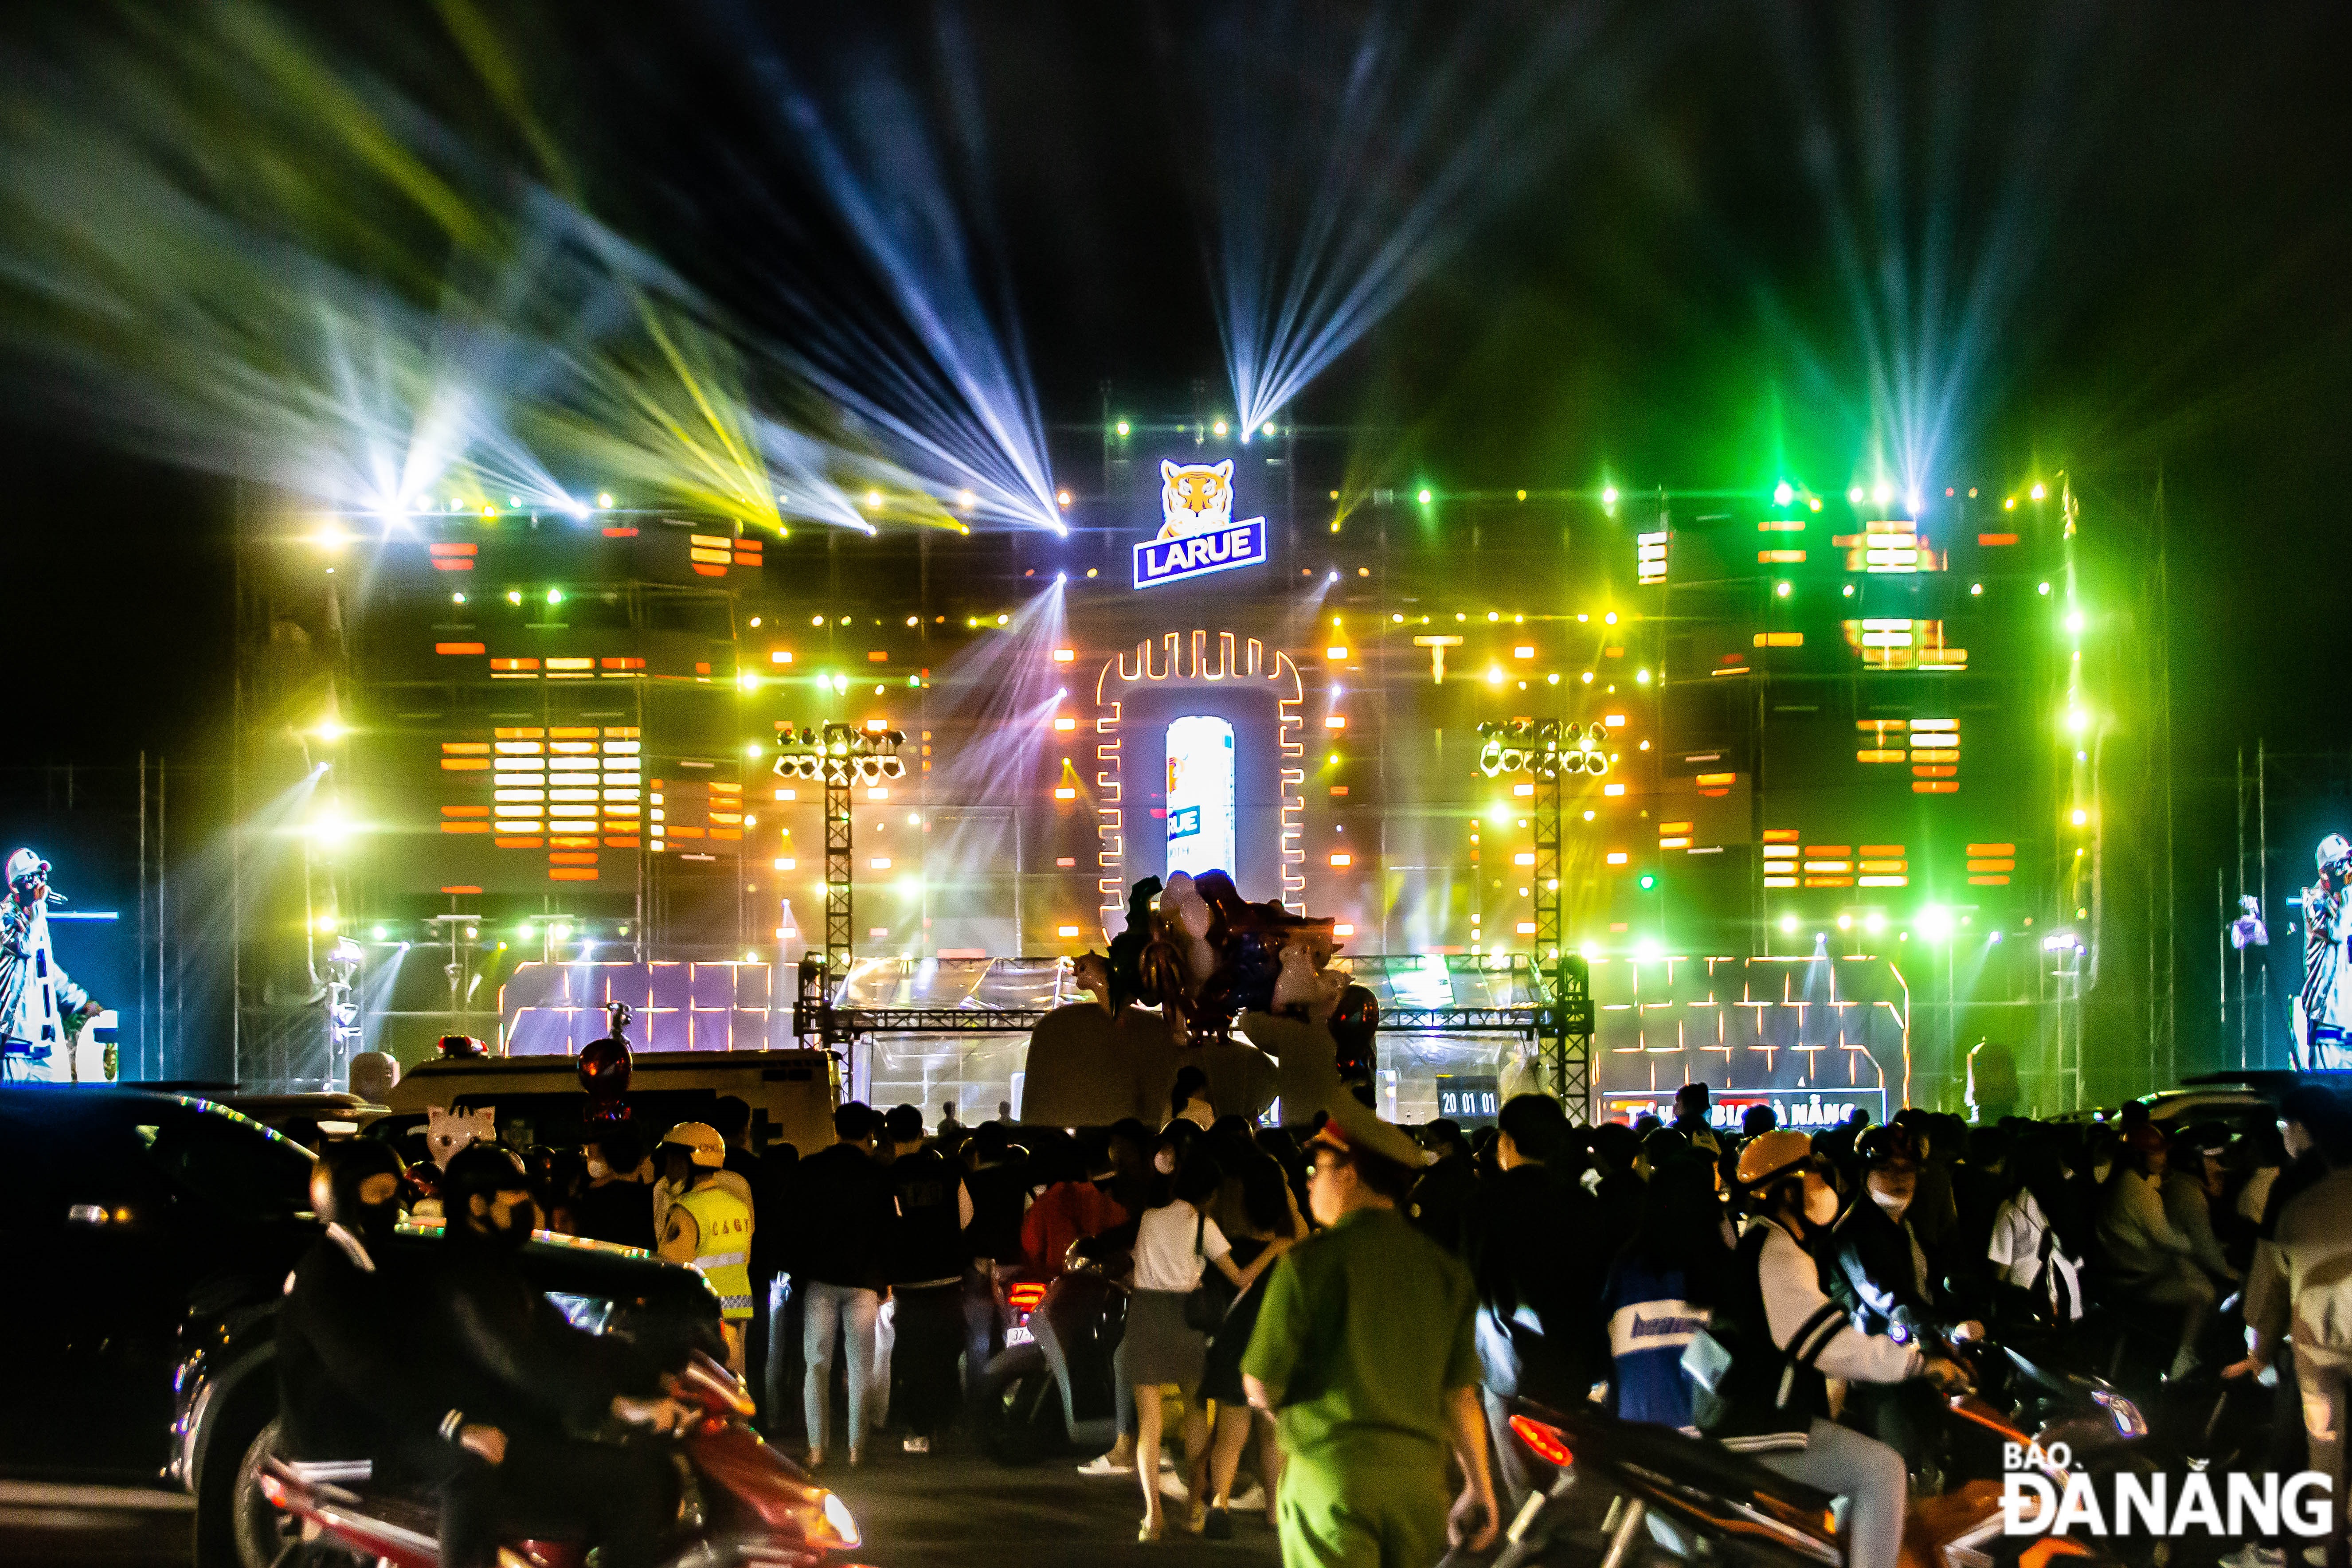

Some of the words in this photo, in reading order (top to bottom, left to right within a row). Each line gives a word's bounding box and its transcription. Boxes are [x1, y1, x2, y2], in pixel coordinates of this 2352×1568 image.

[1146, 528, 1252, 577] LARUE
[1443, 1092, 1457, 1113] 20
[1462, 1092, 1475, 1113] 01
[1481, 1092, 1495, 1113] 01
